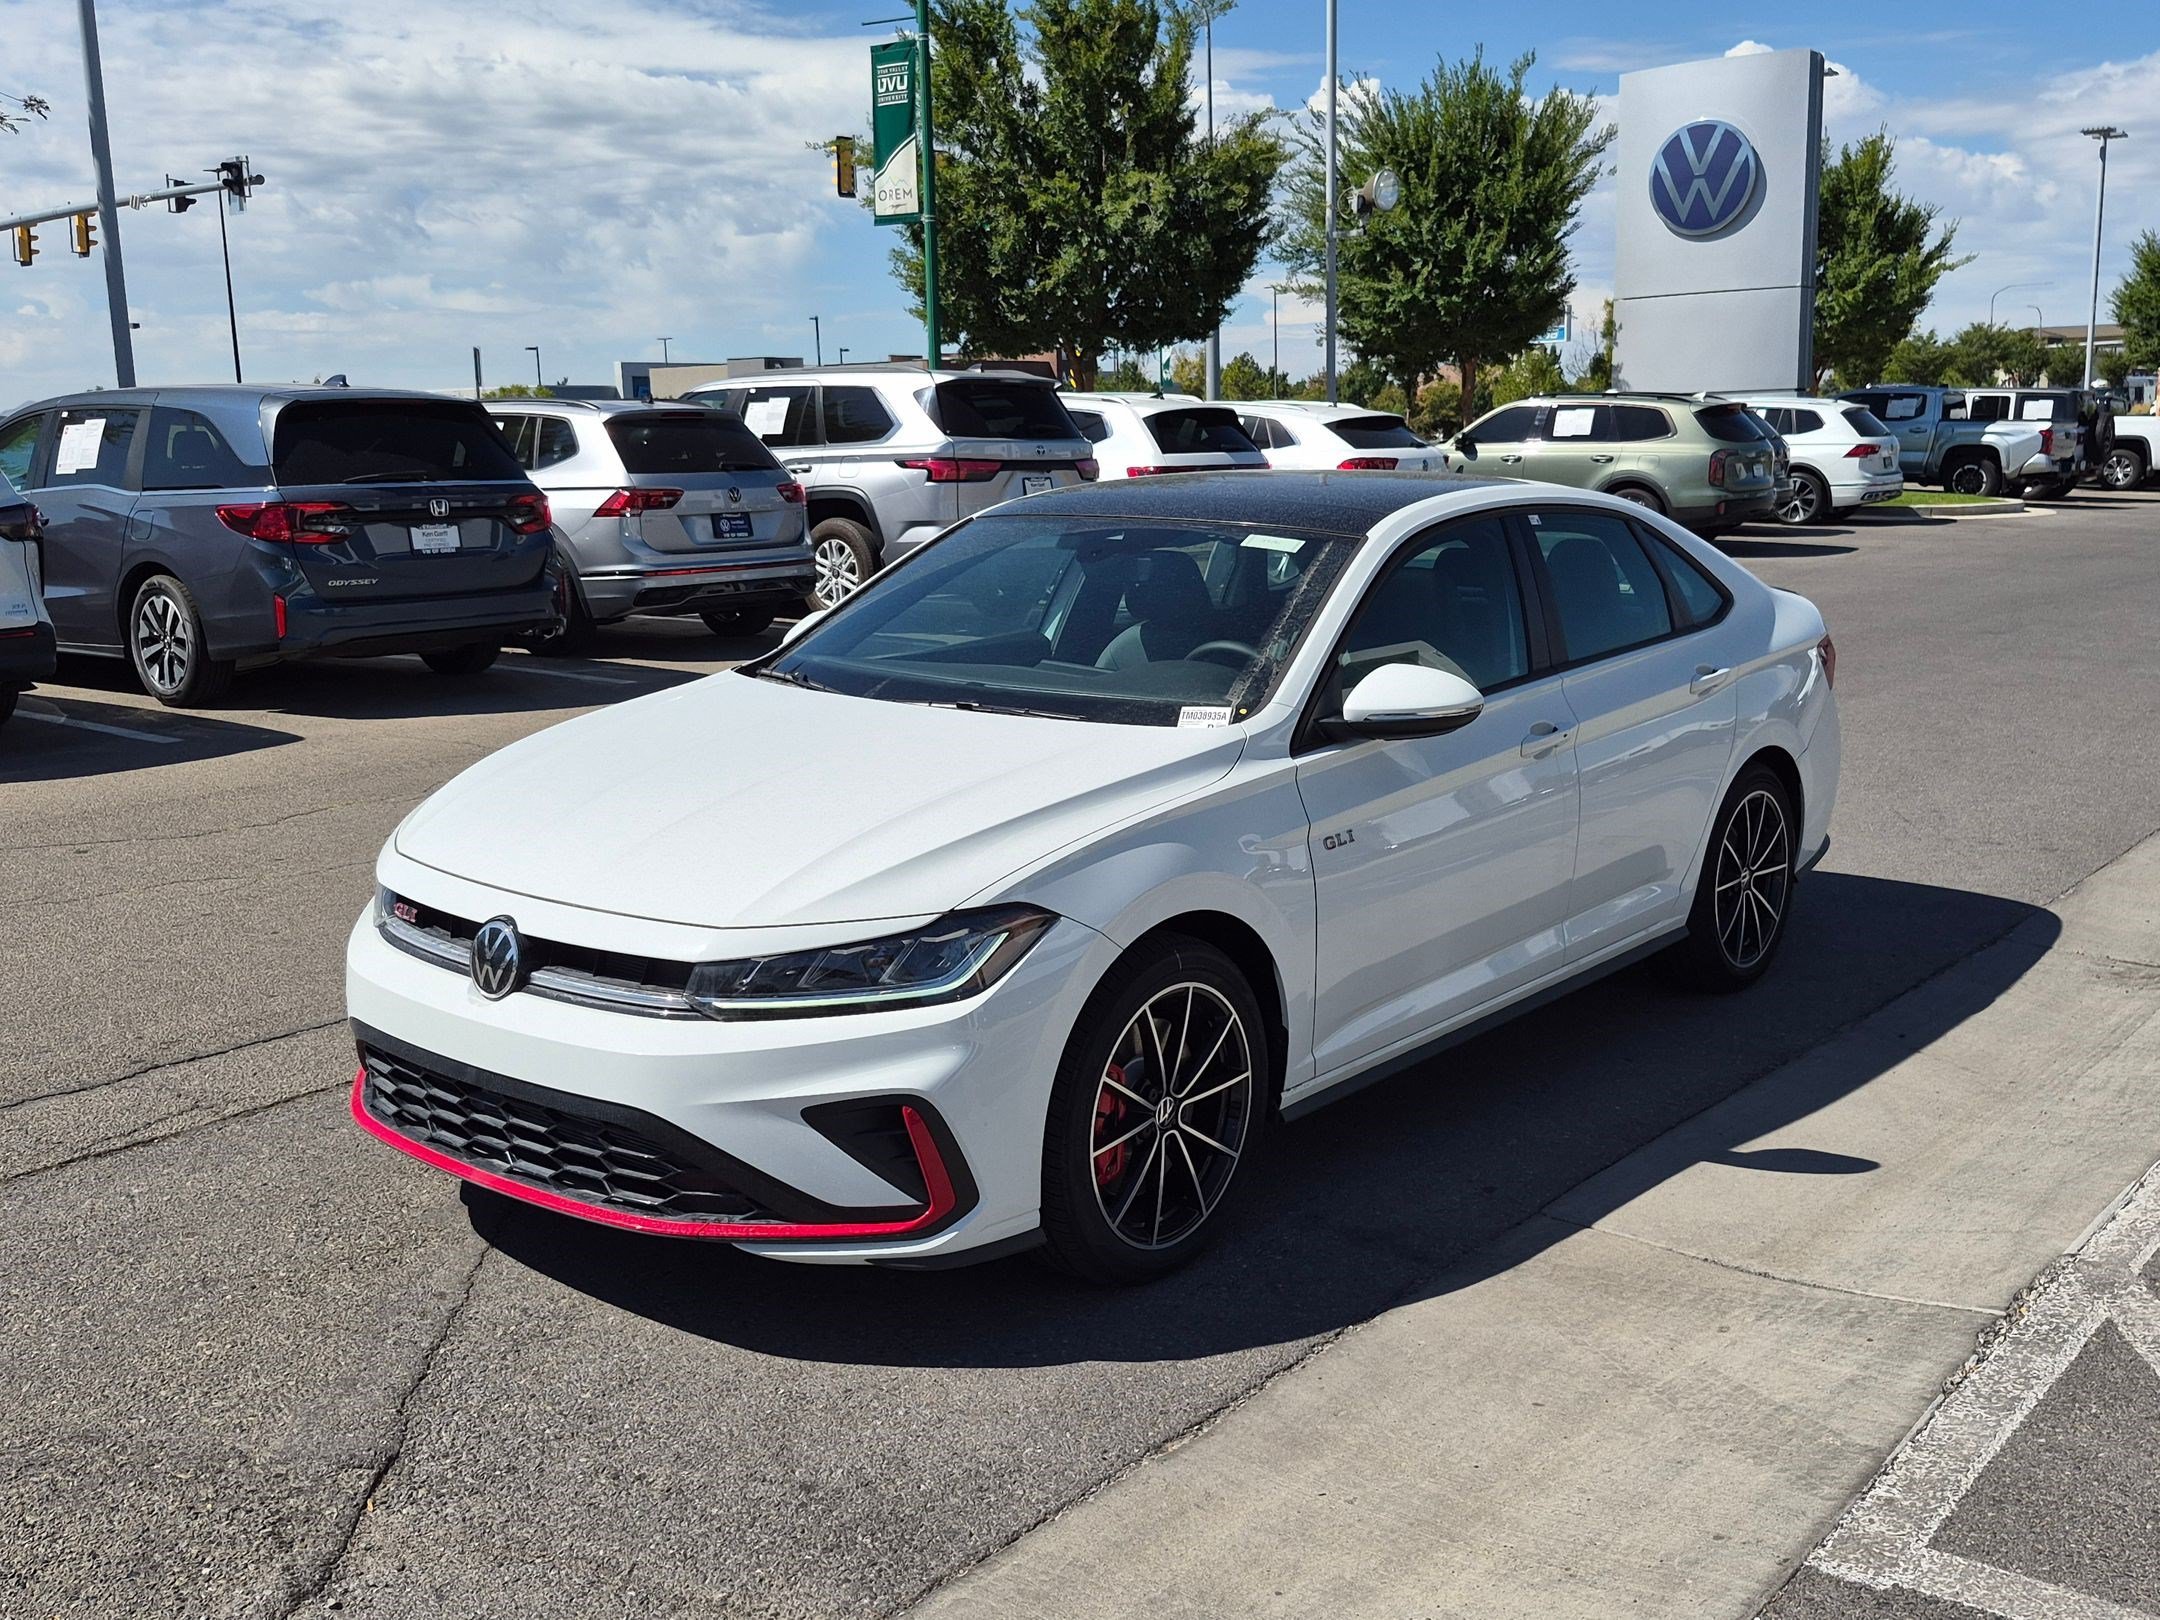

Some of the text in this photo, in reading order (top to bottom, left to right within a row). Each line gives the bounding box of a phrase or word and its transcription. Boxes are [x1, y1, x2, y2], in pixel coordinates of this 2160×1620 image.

[877, 74, 908, 93] UVU
[1650, 120, 1756, 233] VW
[878, 187, 913, 201] OREM
[328, 578, 379, 587] ODYSSEY
[1322, 829, 1356, 850] GLI
[394, 902, 418, 923] GLI
